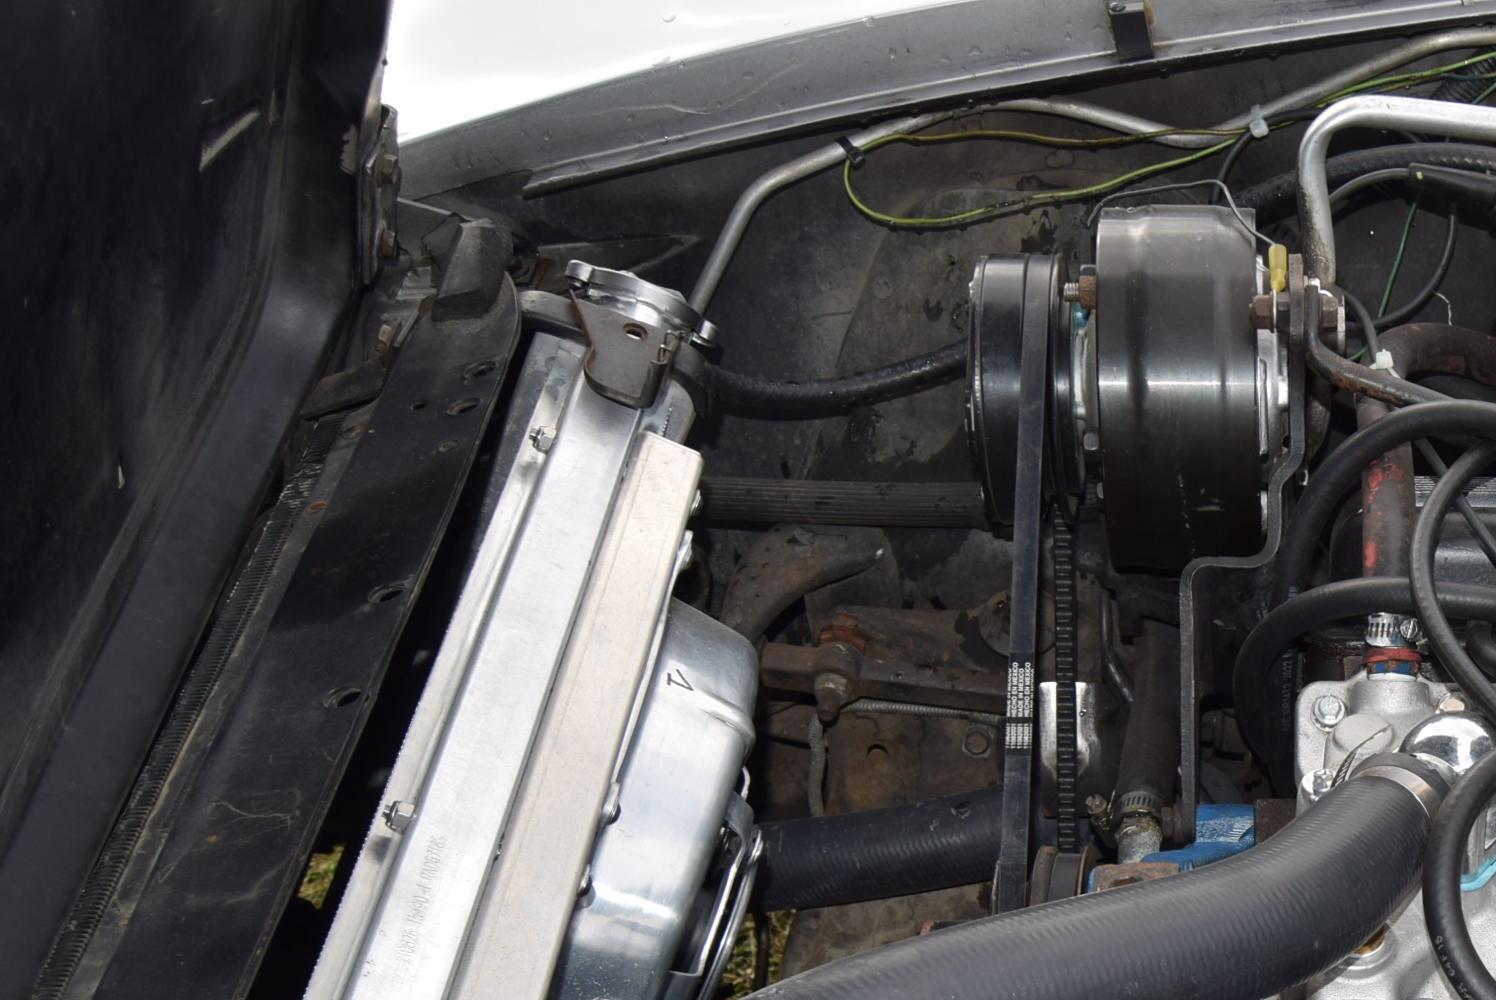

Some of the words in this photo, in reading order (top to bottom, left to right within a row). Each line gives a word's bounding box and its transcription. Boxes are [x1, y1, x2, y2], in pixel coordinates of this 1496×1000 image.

[1011, 662, 1019, 685] MEXICO
[1017, 668, 1025, 692] MEXICO
[1024, 662, 1032, 685] MEXICO
